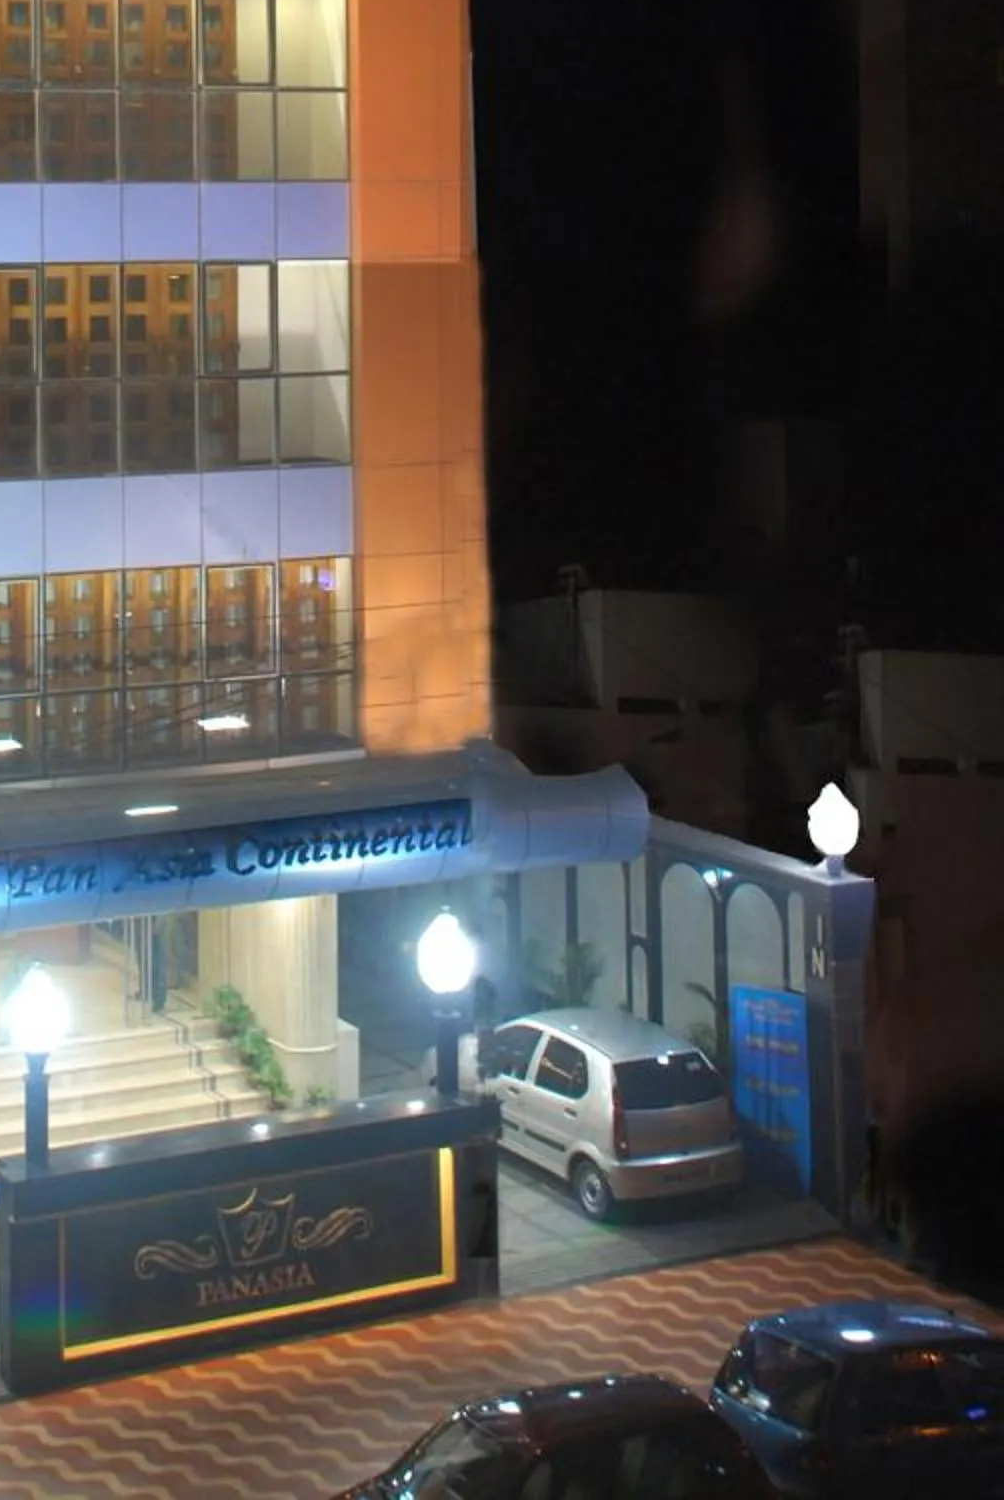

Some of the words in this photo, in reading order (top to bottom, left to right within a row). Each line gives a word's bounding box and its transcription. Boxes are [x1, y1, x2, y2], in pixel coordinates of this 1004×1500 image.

[9, 856, 99, 898] Pan
[226, 812, 475, 877] Continental
[196, 1262, 316, 1307] PANASIA
